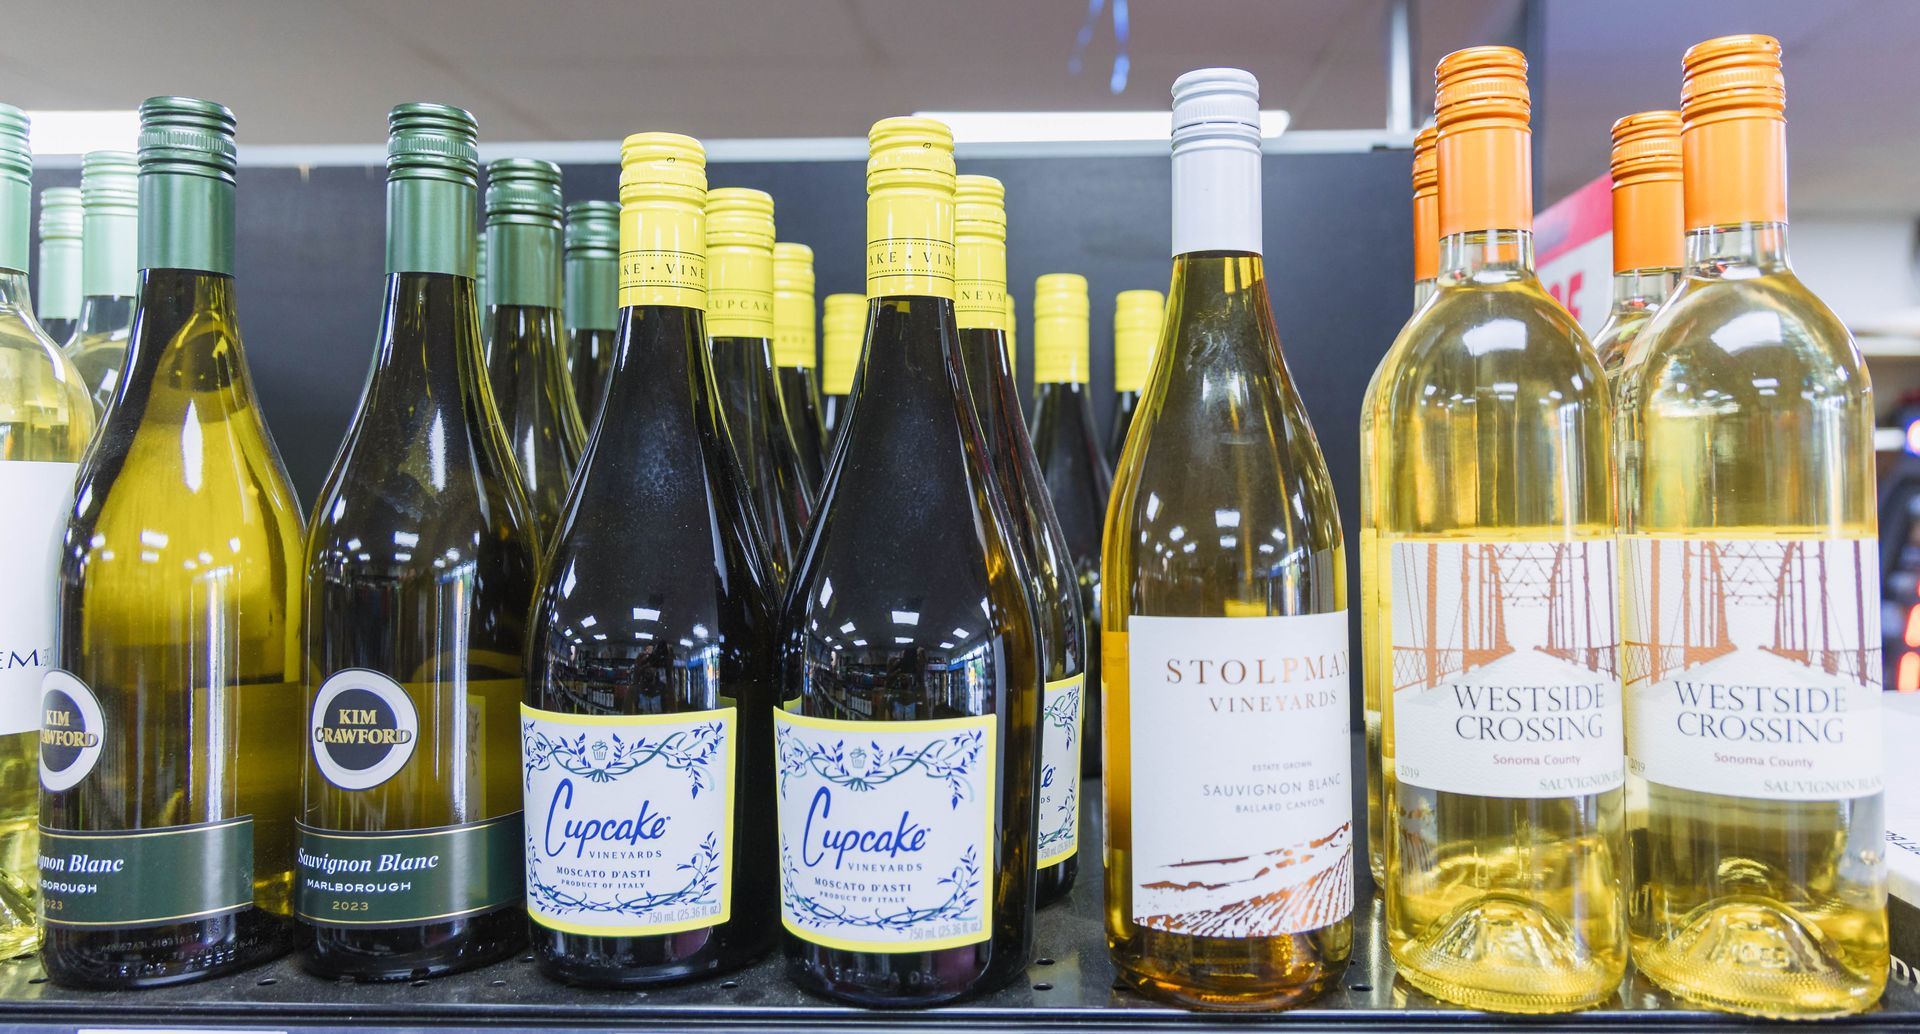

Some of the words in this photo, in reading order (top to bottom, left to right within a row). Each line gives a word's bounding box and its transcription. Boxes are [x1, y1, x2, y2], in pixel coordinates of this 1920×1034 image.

[666, 263, 705, 280] VINE
[706, 299, 772, 312] CUPCAK
[1209, 689, 1337, 713] VINEYARDS
[1453, 683, 1605, 713] WESTSIDE
[1675, 681, 1847, 713] WESTSIDE
[47, 709, 70, 727] KIM
[339, 709, 377, 725] KIM
[315, 726, 412, 745] CRAWFORD
[1456, 714, 1603, 742] CROSSING
[1677, 711, 1844, 744] CROSSING
[1252, 763, 1280, 772] ESTATE
[1493, 754, 1541, 766] Sonoma
[1543, 754, 1581, 767] County
[1714, 752, 1765, 767] Sonoma
[1769, 755, 1814, 769] County
[1203, 781, 1302, 797] SAUVIGNON
[1308, 772, 1341, 791] BLANC
[1763, 778, 1856, 793] SAUVIGNON
[1235, 803, 1282, 813] BALLARD
[1286, 798, 1325, 811] CANYON
[545, 777, 666, 859] Cupcake
[803, 786, 927, 871] Cupcake
[68, 854, 125, 872] Blanc
[298, 847, 373, 875] Sauvignon
[376, 853, 440, 873] Blanc
[589, 850, 662, 860] VINEYARDS
[556, 865, 606, 879] MOSCATO
[611, 869, 651, 879] D'ASTI
[848, 862, 923, 873] VINEYARDS
[307, 878, 412, 893] MARLBOROUGH
[561, 879, 598, 889] PRODUCT
[815, 876, 865, 892] MOSCATO
[871, 883, 912, 893] D'ASTI
[332, 900, 369, 911] 2023
[820, 890, 857, 902] PRODUCT
[861, 894, 873, 903] OF
[877, 895, 907, 904] ITALY
